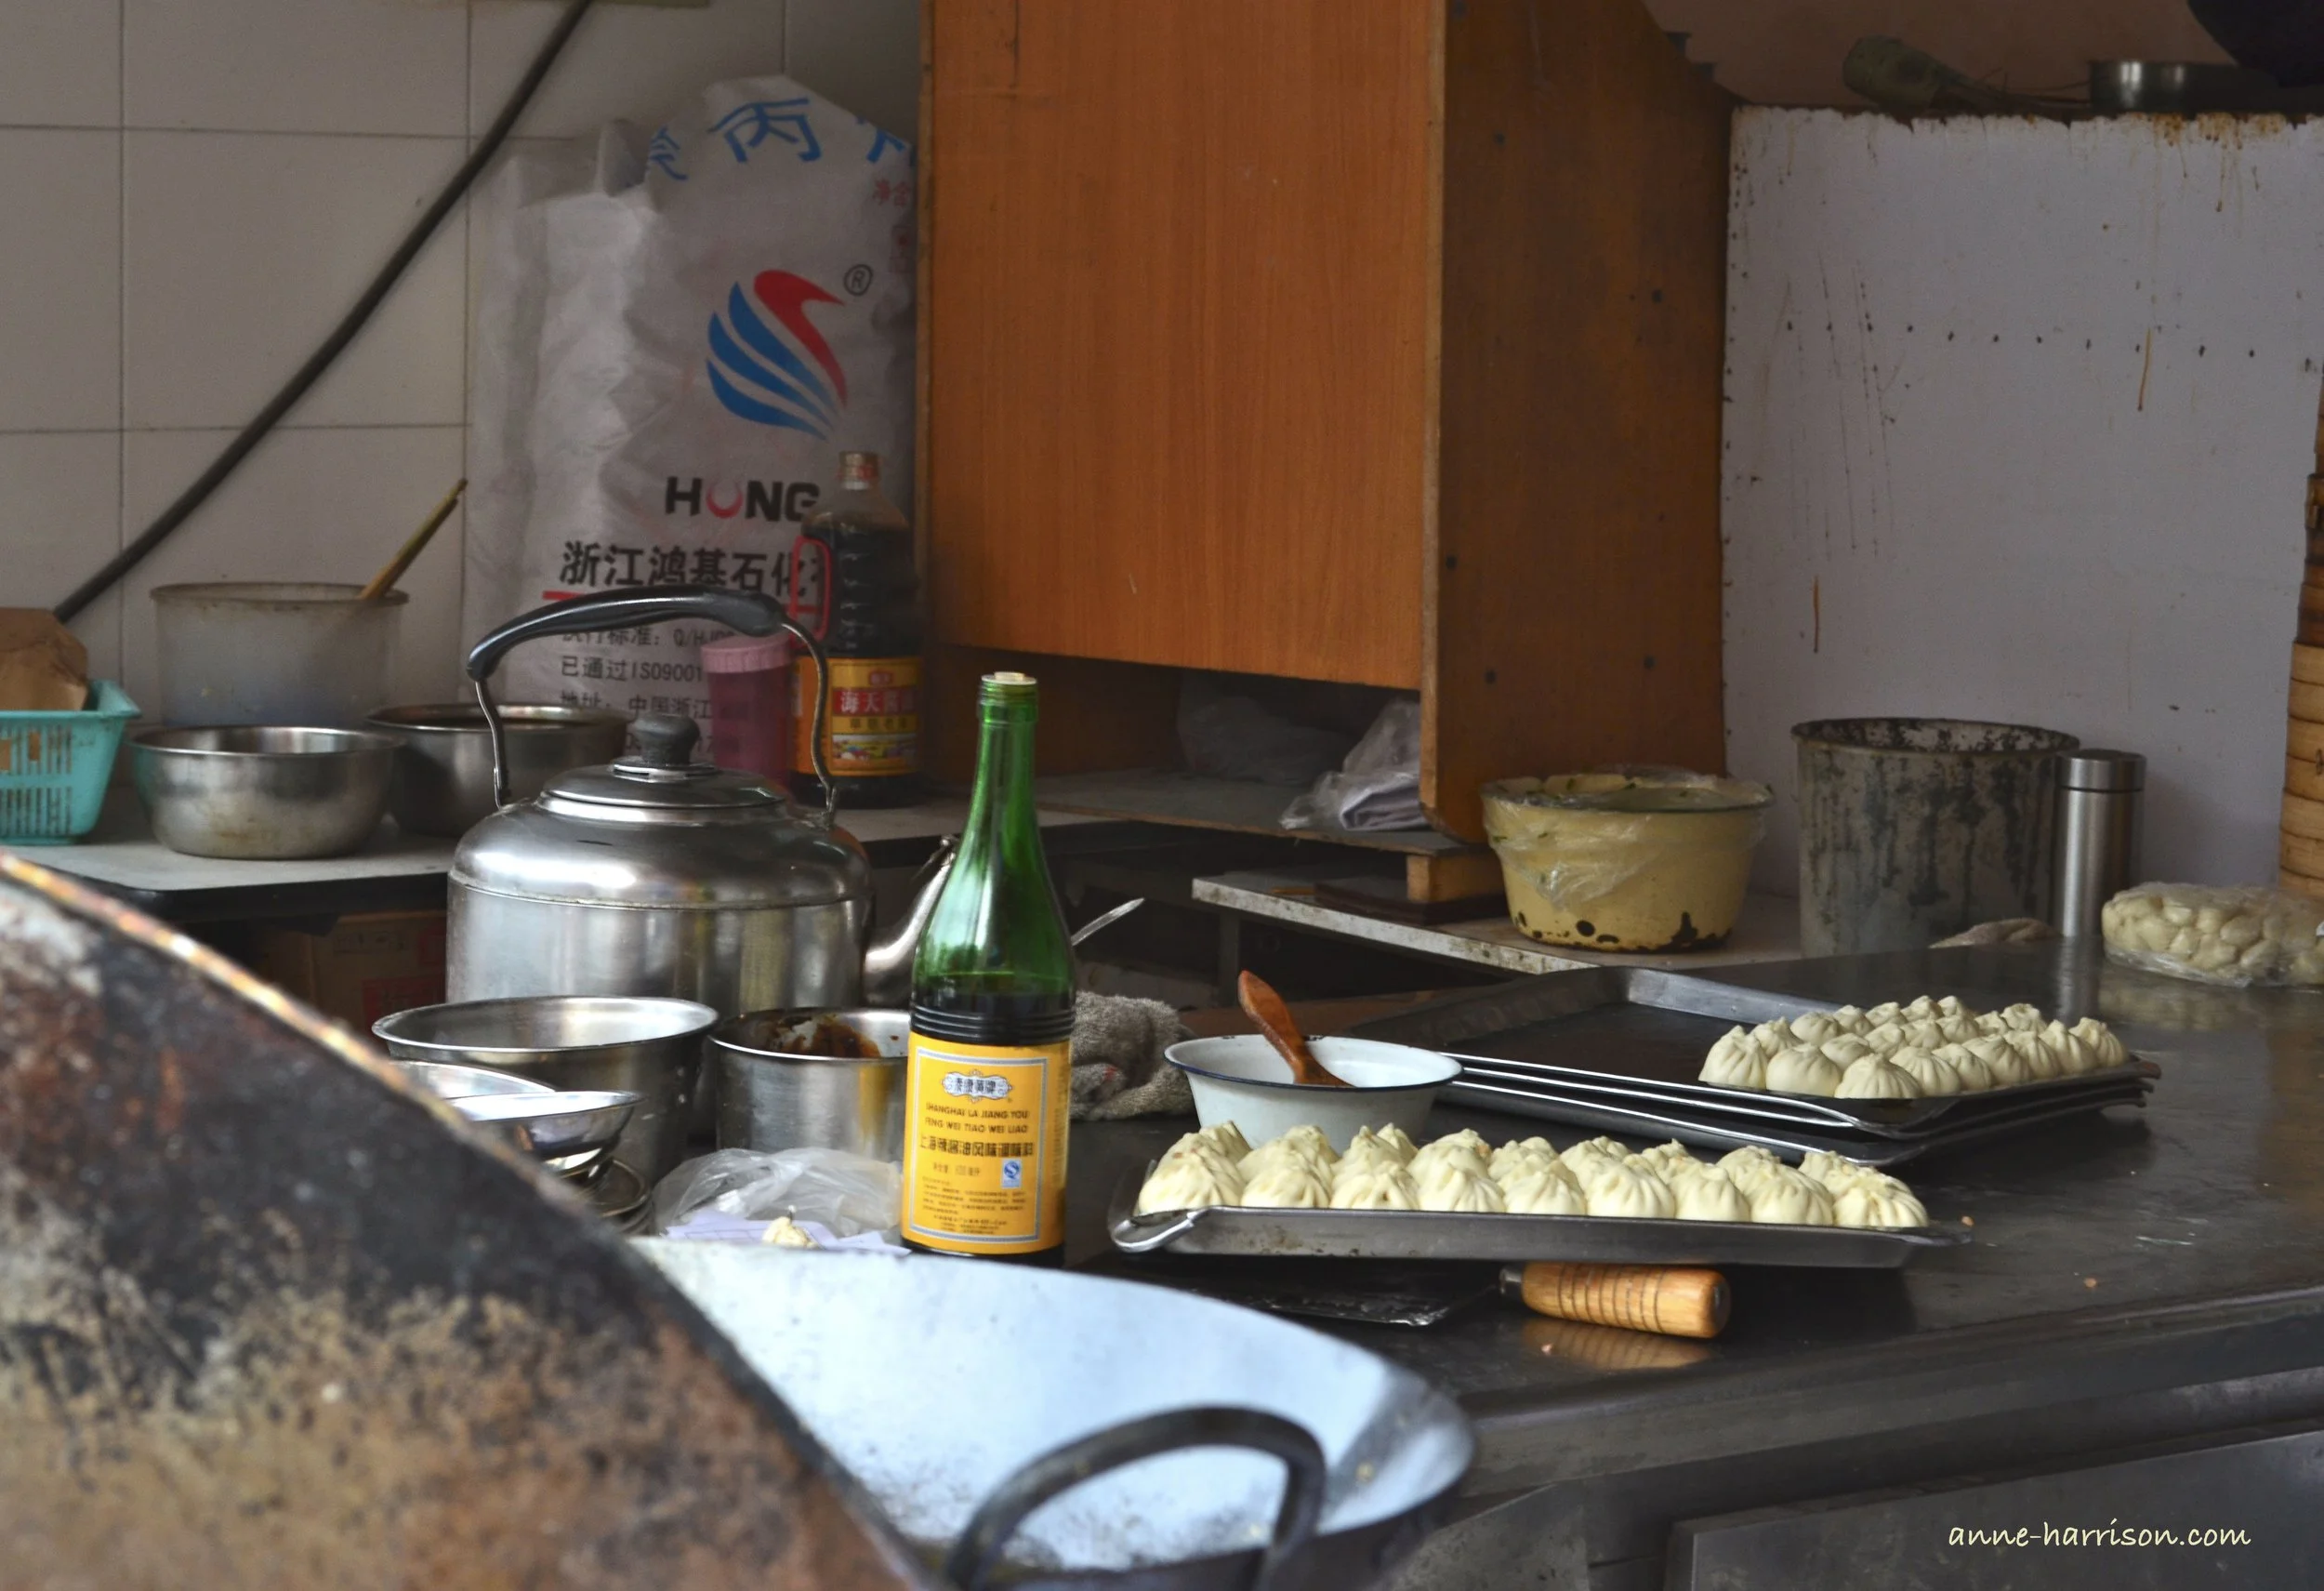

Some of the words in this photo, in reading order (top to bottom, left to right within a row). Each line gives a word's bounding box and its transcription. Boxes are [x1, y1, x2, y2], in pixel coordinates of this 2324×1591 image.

[560, 540, 819, 597] 浙江鸿基石化
[926, 1102, 965, 1117] SHANGHAI
[946, 1121, 961, 1131] WEI
[988, 1124, 1004, 1134] WEI
